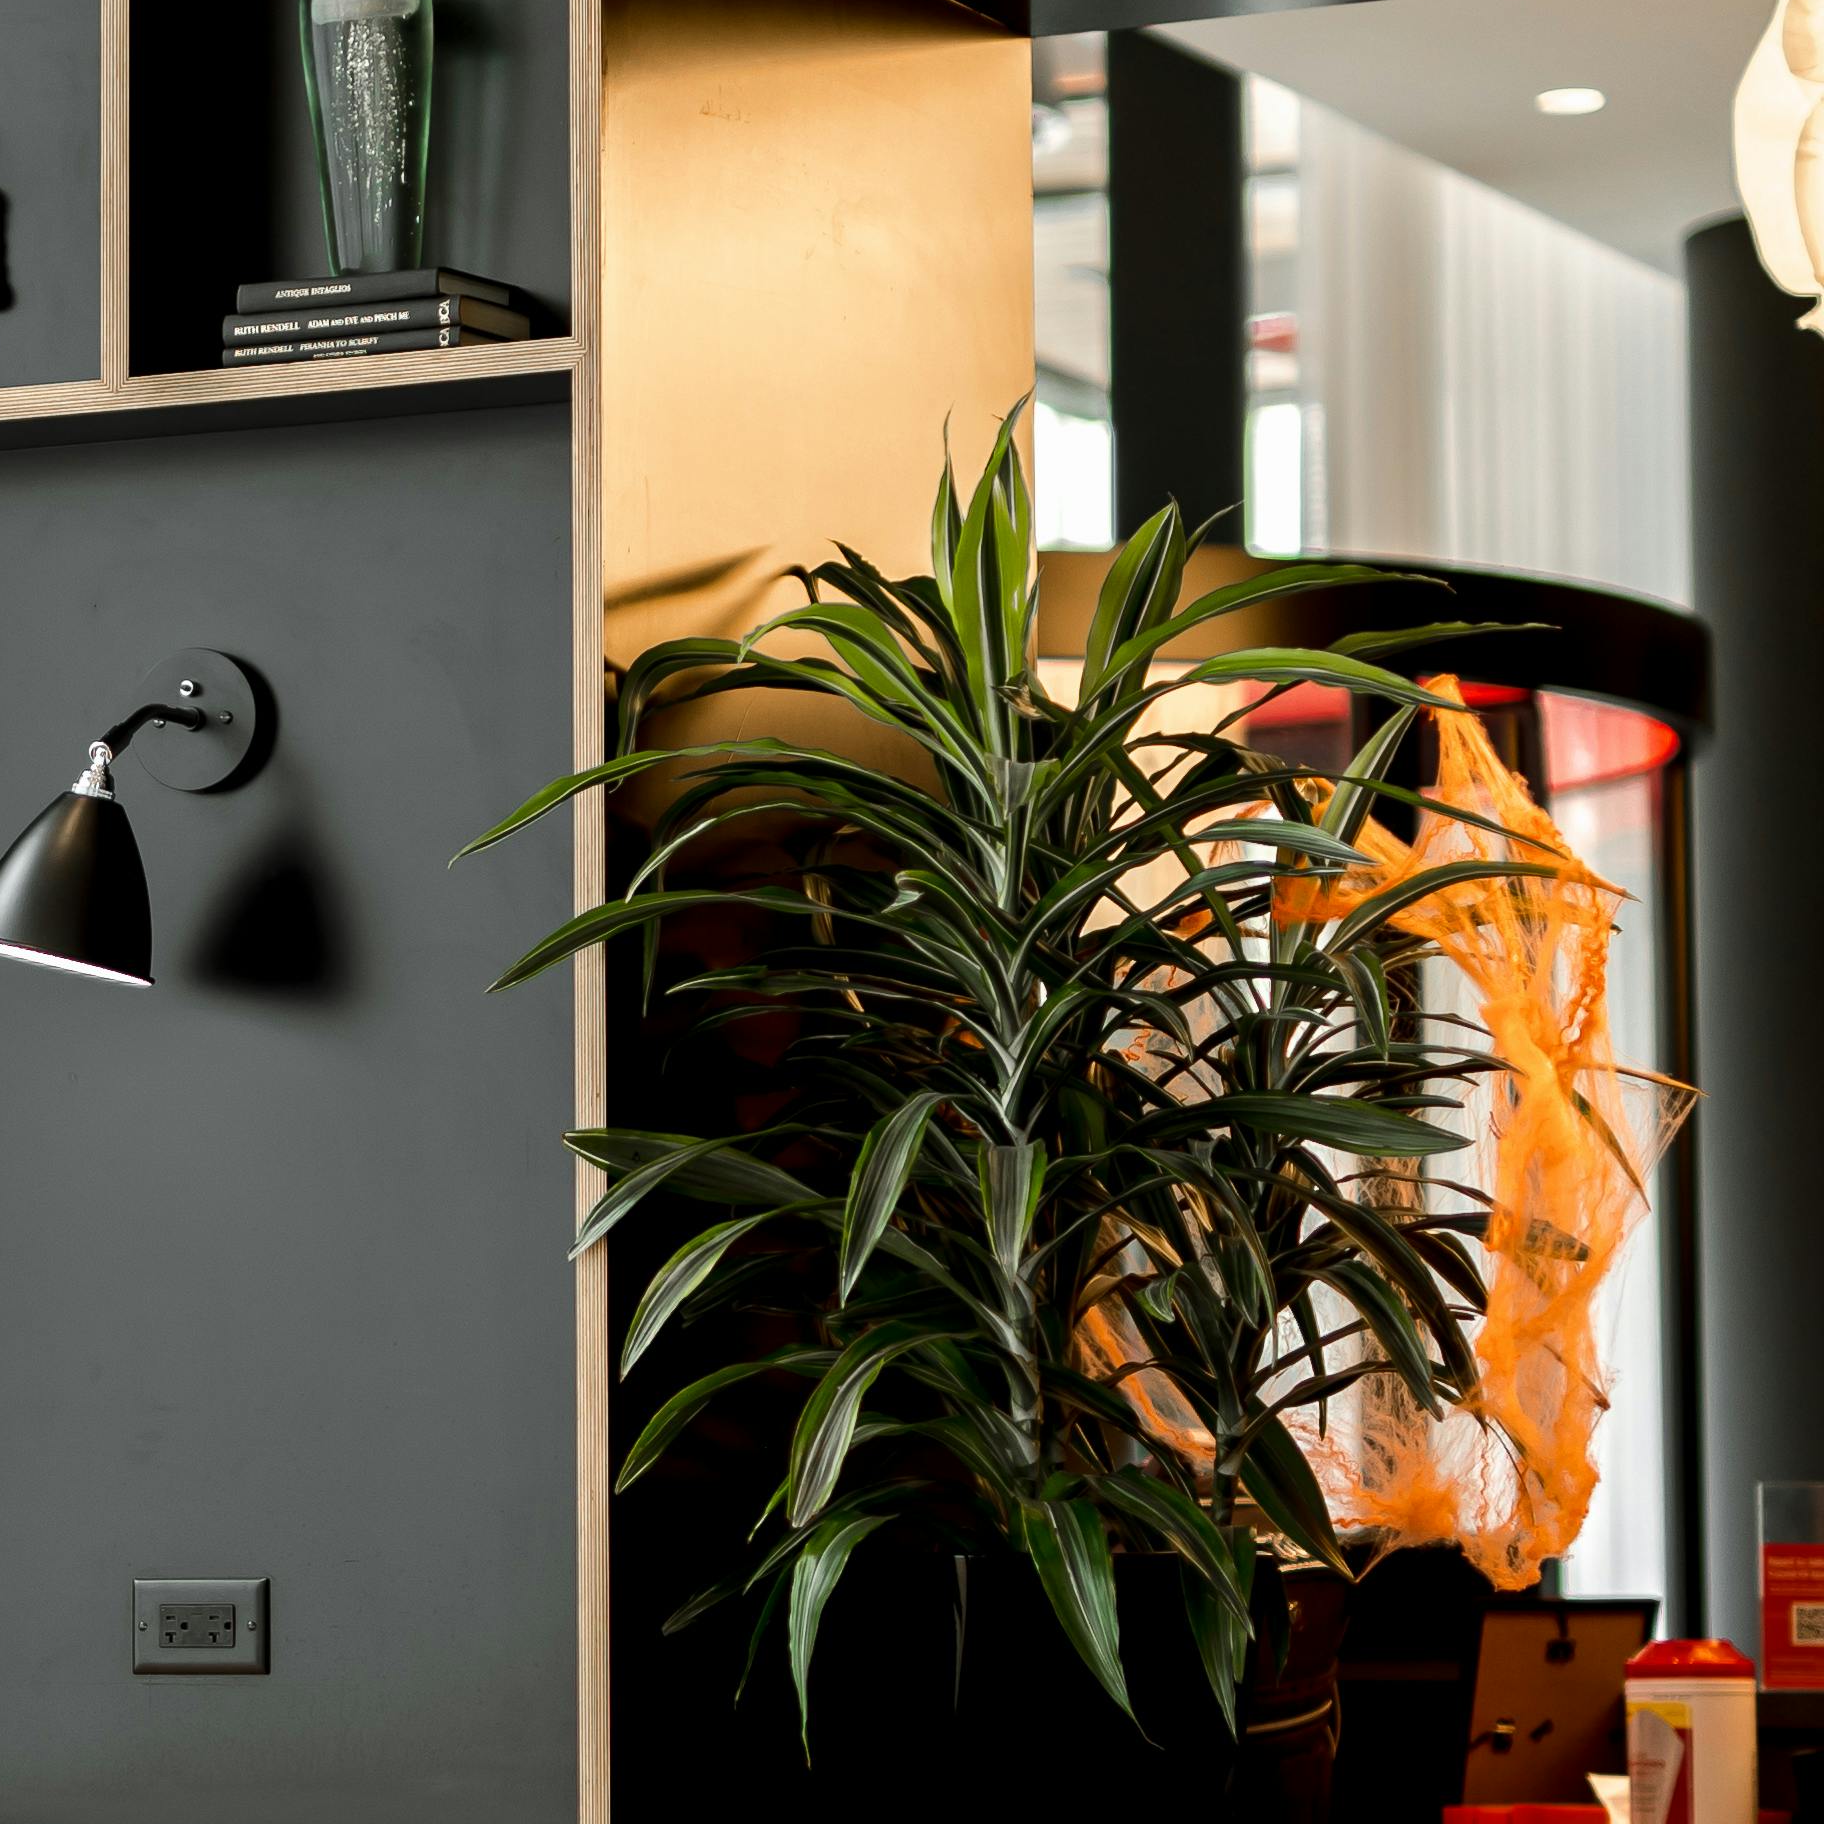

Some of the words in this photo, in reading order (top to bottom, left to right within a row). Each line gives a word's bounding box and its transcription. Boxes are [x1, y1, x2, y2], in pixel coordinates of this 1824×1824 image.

[275, 288, 309, 298] ANTIQUE
[311, 284, 351, 296] INTAGLIOS
[438, 299, 450, 324] BCA
[234, 325, 259, 336] RUTH
[260, 322, 300, 333] RENDELL
[308, 319, 329, 329] ADAM
[344, 316, 359, 325] EVE
[234, 348, 257, 357] RUTH
[258, 345, 294, 355] RENDELL
[336, 340, 347, 348] TO
